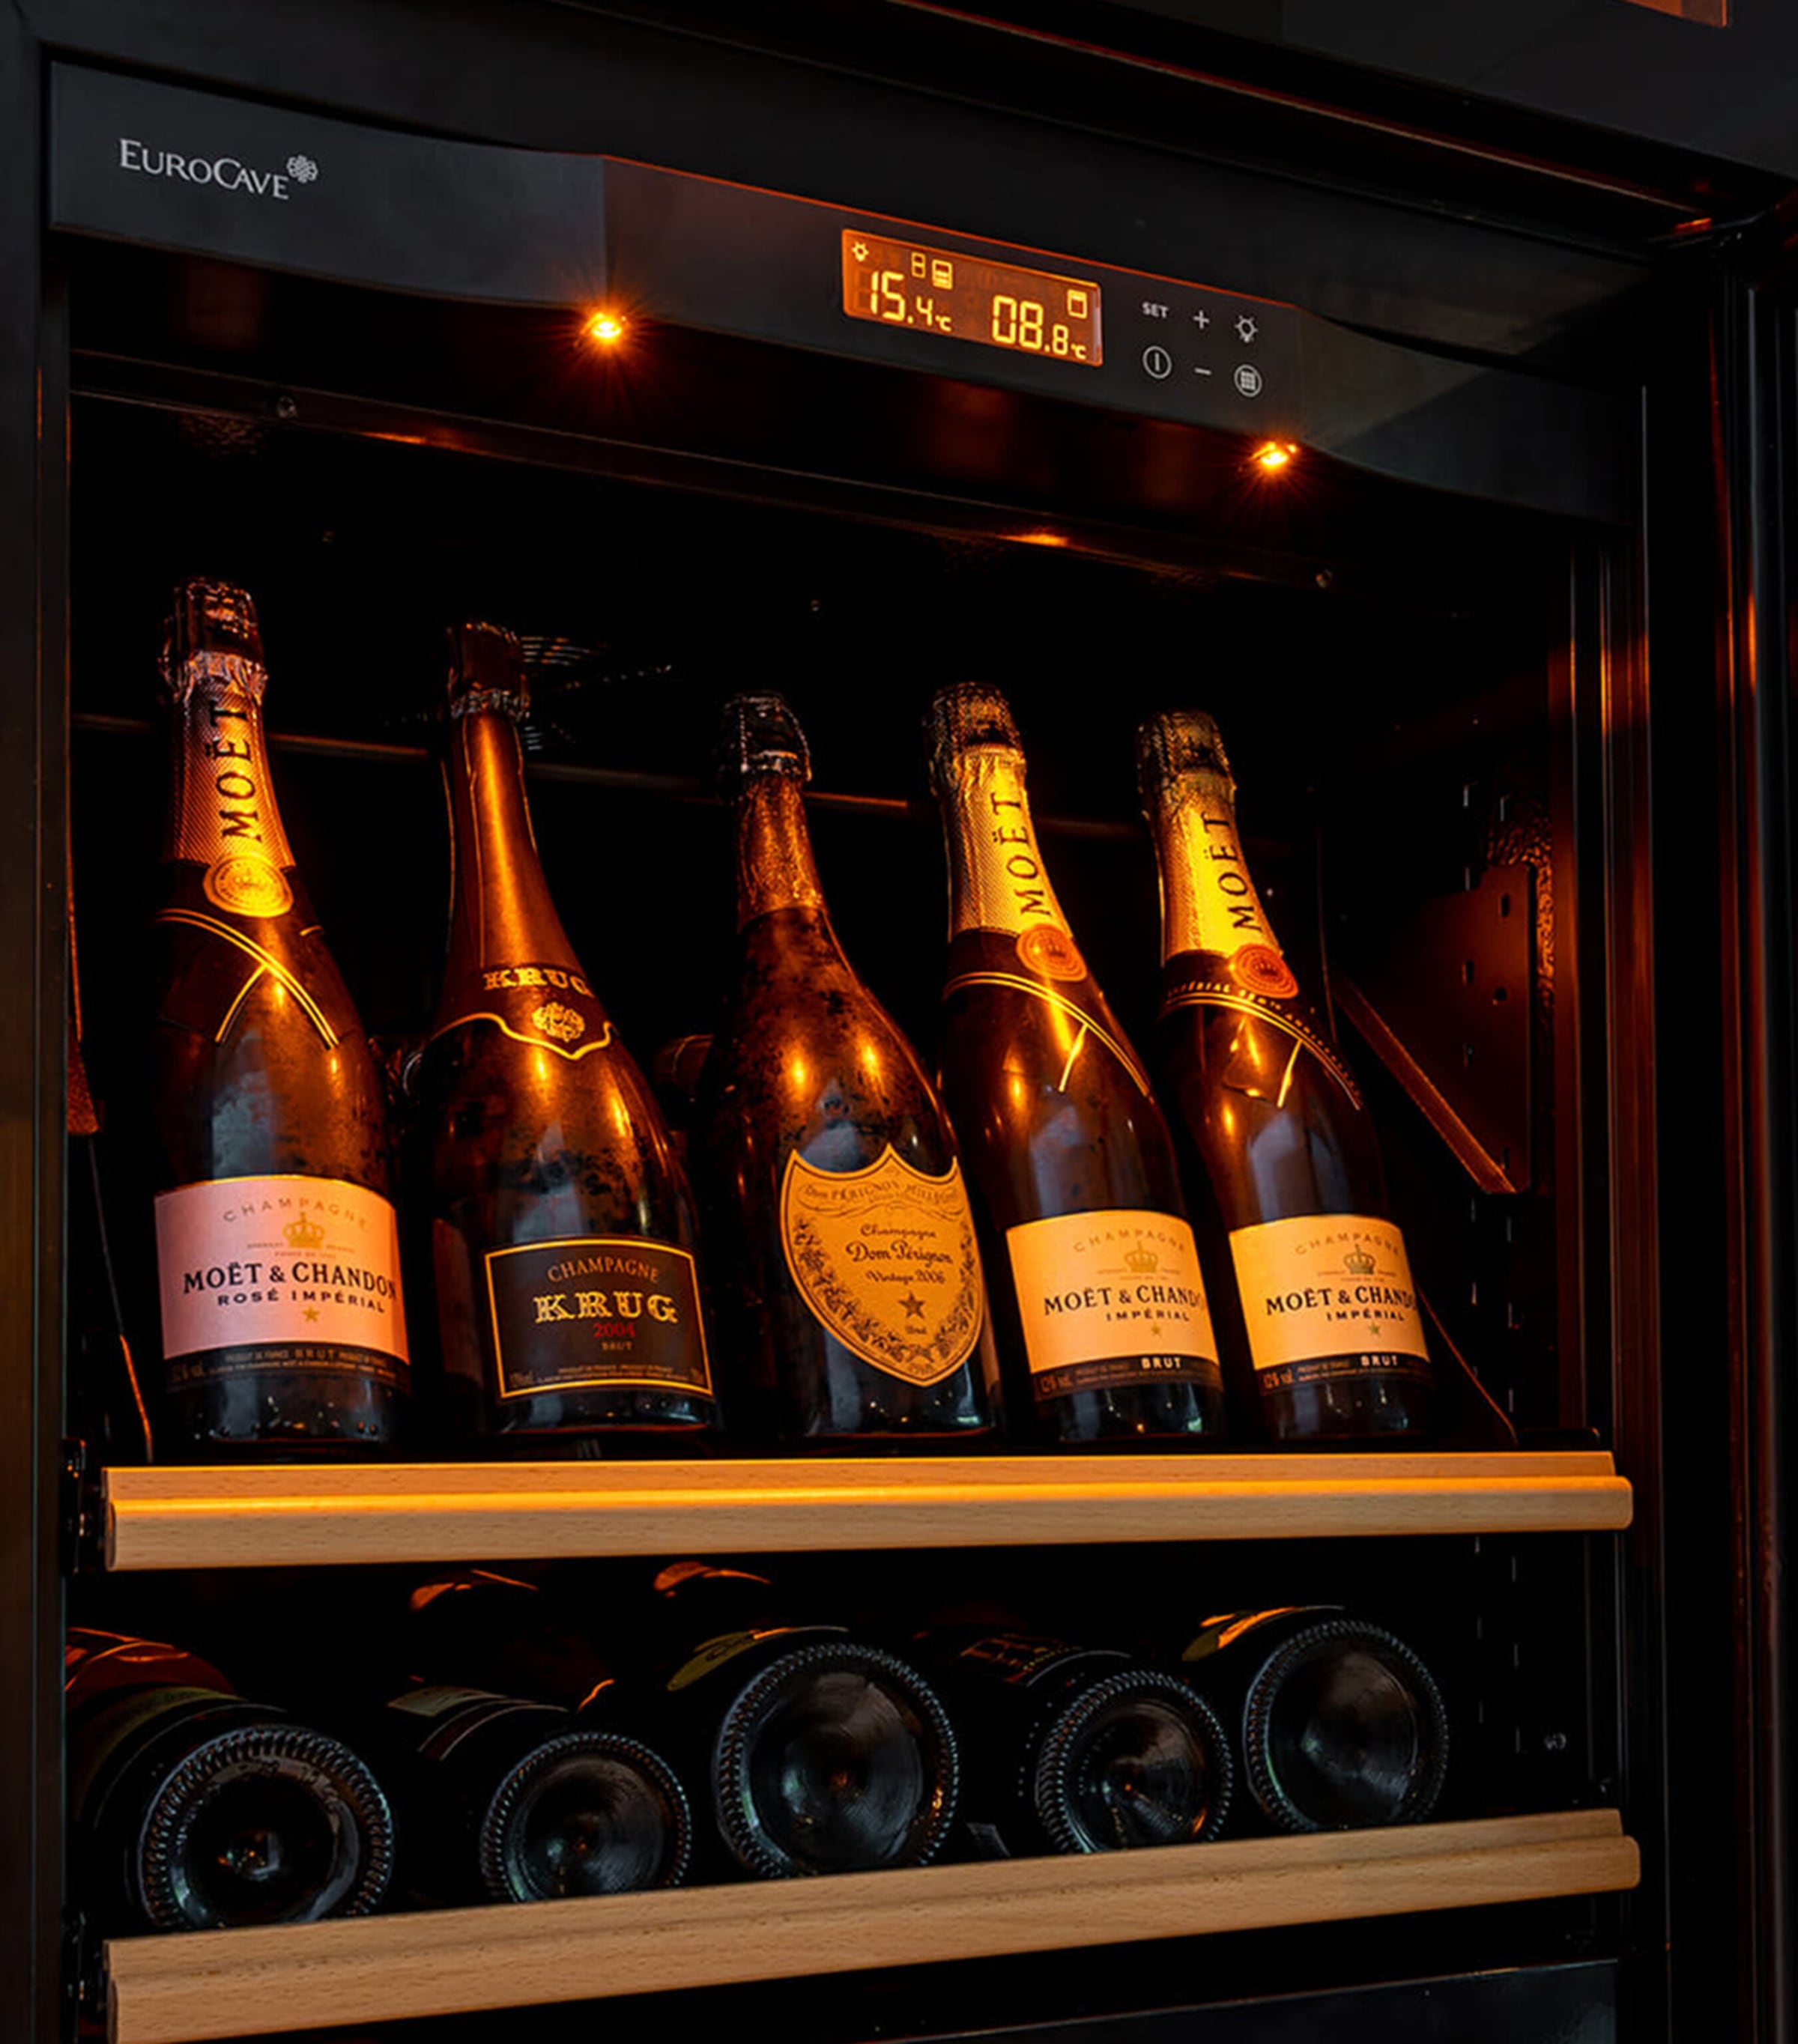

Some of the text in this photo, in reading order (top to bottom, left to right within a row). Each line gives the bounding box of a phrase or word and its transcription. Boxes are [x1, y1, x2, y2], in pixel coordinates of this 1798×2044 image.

[1142, 301, 1169, 318] SET
[204, 700, 262, 843] MOËT
[990, 792, 1052, 917] MOËT
[1200, 812, 1262, 933] MOËT
[223, 1197, 369, 1228] CHAMPAGNE
[845, 1240, 892, 1263] Dom
[1073, 1228, 1184, 1253] CHAMPAGNE
[1295, 1232, 1399, 1256] CHAMPAGNE
[184, 1261, 262, 1294] MOËT
[269, 1264, 286, 1283] &
[547, 1256, 661, 1284] CHAMPAGNE
[217, 1288, 385, 1313] ROSÉ IMPÉRIAL
[533, 1291, 679, 1324] KRUG
[1043, 1287, 1112, 1316] MOËT
[1118, 1289, 1132, 1305] &
[1265, 1288, 1333, 1316] MOËT
[1338, 1289, 1351, 1305] &
[1107, 1308, 1190, 1322] IMPÉRIAL
[1326, 1307, 1405, 1322] IMPÉRIAL
[1140, 1356, 1182, 1370] BRUT
[1360, 1354, 1398, 1367] BRUT
